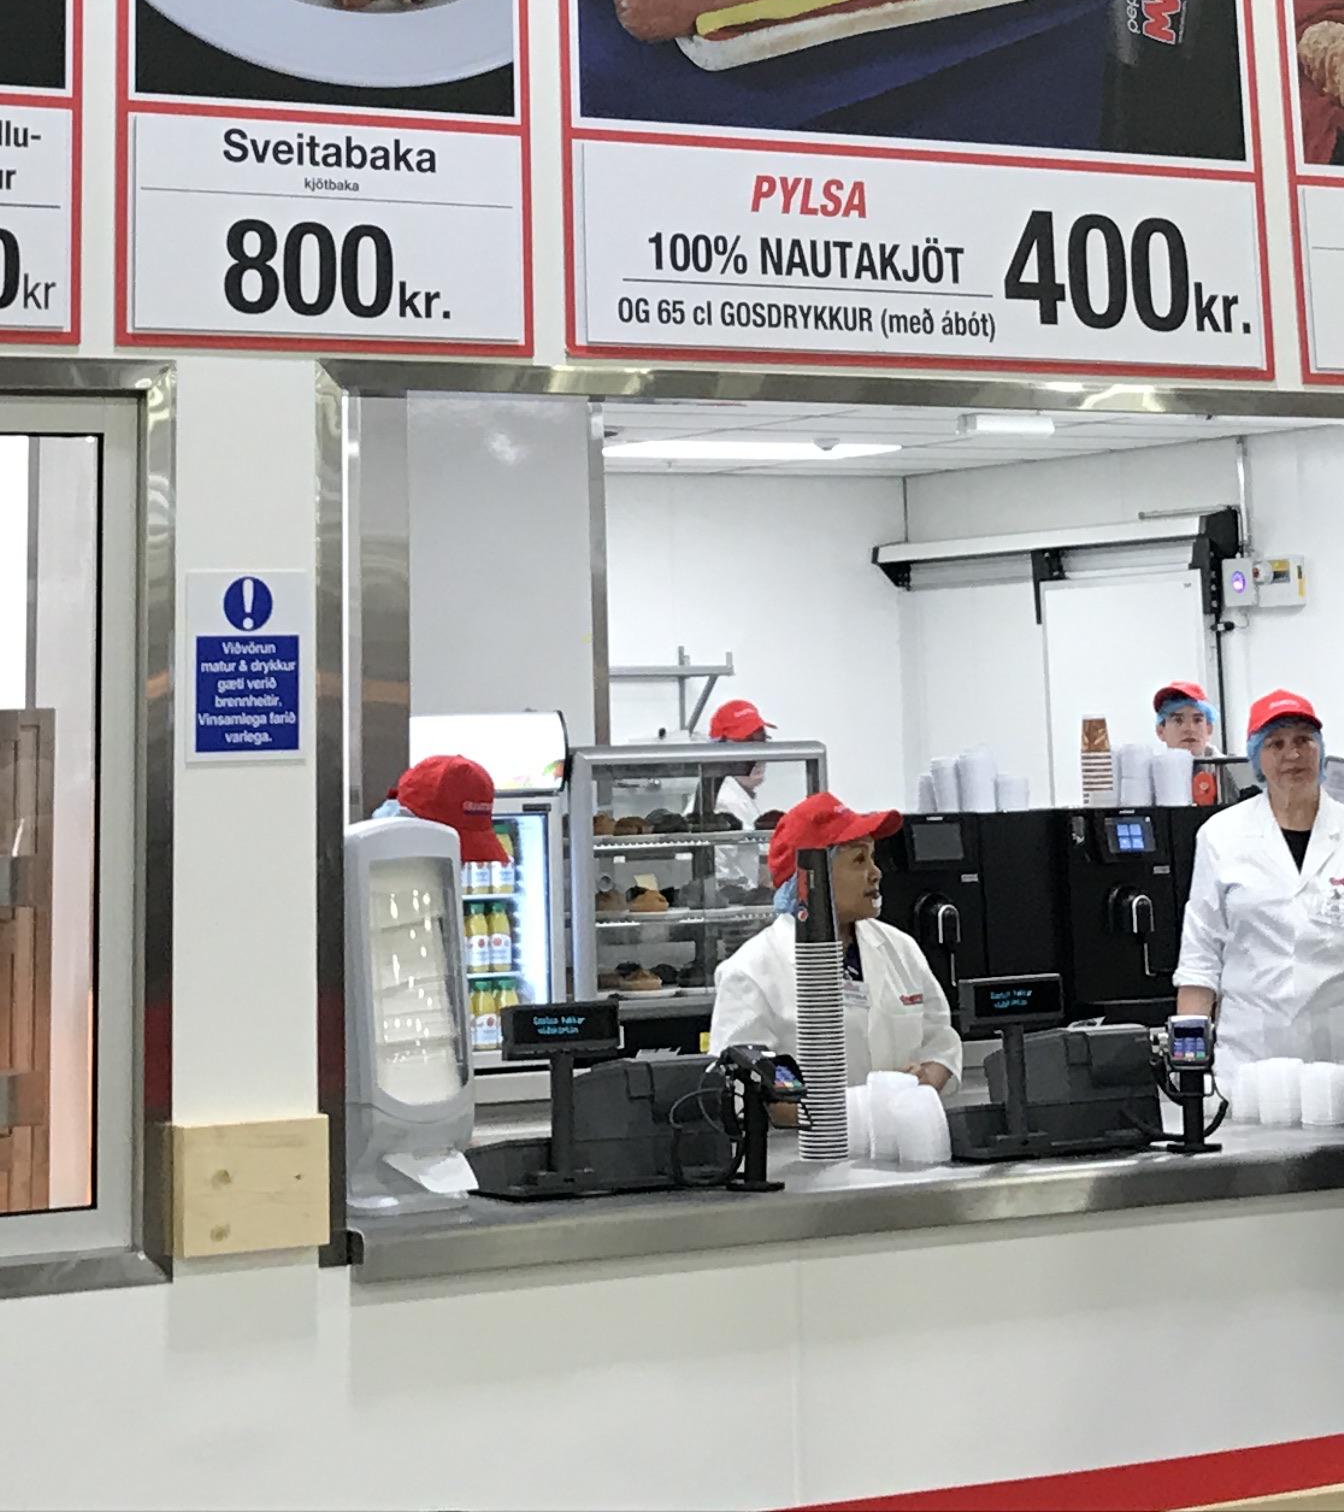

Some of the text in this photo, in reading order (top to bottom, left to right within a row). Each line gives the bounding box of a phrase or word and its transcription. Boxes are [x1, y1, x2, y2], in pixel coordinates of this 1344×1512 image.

[223, 128, 437, 173] Sveitabaka
[304, 177, 360, 193] kjötbaka
[751, 174, 868, 219] PYLSA
[224, 218, 452, 320] 800 kr.
[648, 232, 964, 285] 100% NAUTAKJÖT
[1003, 210, 1252, 335] 400 kr.
[23, 274, 56, 310] kr
[618, 298, 996, 343] OG 65 cl GOSDRYKKUR (með ábót)
[201, 659, 296, 674] matur & drykkur
[222, 641, 276, 655] Viðvörun
[217, 677, 277, 693] gæti verið
[198, 711, 296, 727] Vinsamlega farið
